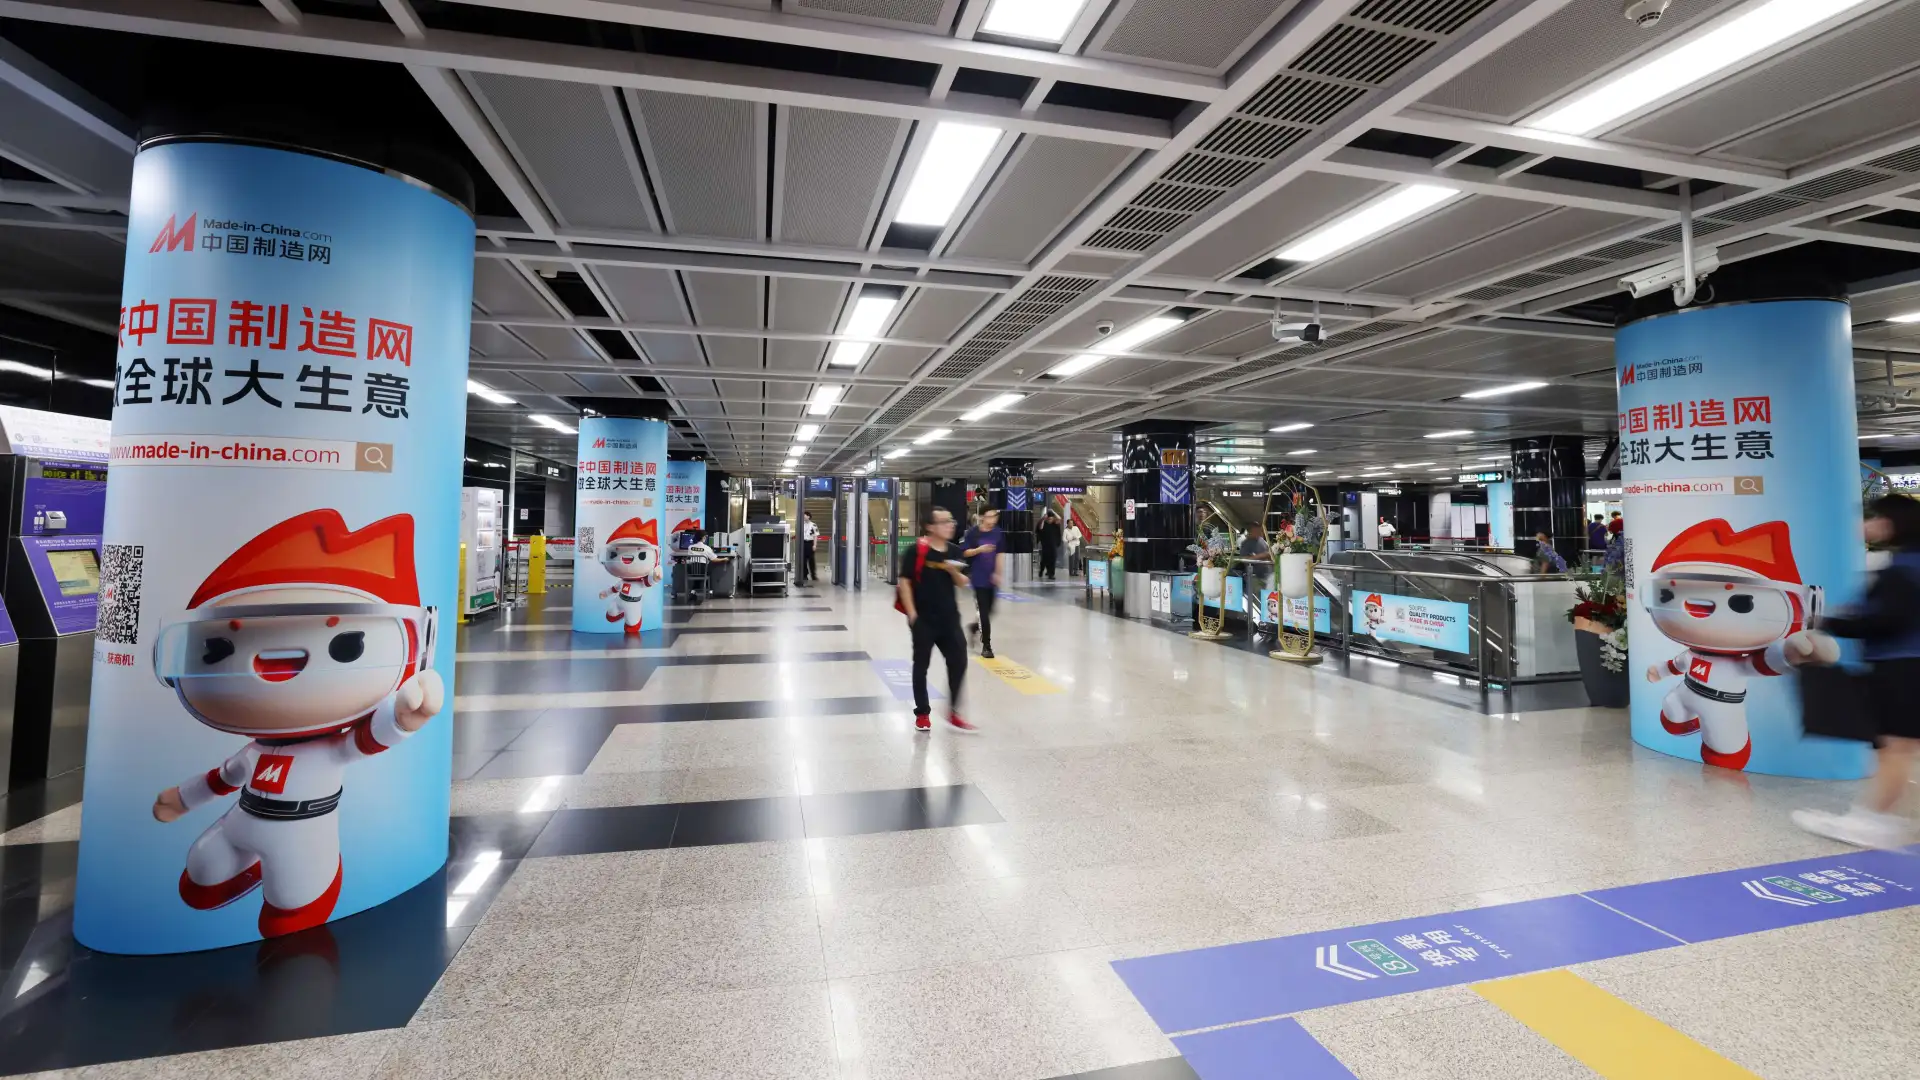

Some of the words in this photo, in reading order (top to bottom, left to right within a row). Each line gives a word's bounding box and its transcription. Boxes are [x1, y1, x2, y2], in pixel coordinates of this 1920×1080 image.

[203, 219, 332, 243] Made-in-China.com
[202, 233, 331, 265] 中国制造网
[1636, 355, 1703, 370] Made-in-China.com
[1636, 362, 1703, 383] 中国制造网
[1620, 430, 1775, 466] 全球大生意
[1429, 613, 1456, 622] PRODUCTS
[107, 652, 135, 666] 获商机!
[1393, 933, 1460, 968] 换乘
[1422, 929, 1480, 963] 专用
[1452, 924, 1514, 960] Transfer
